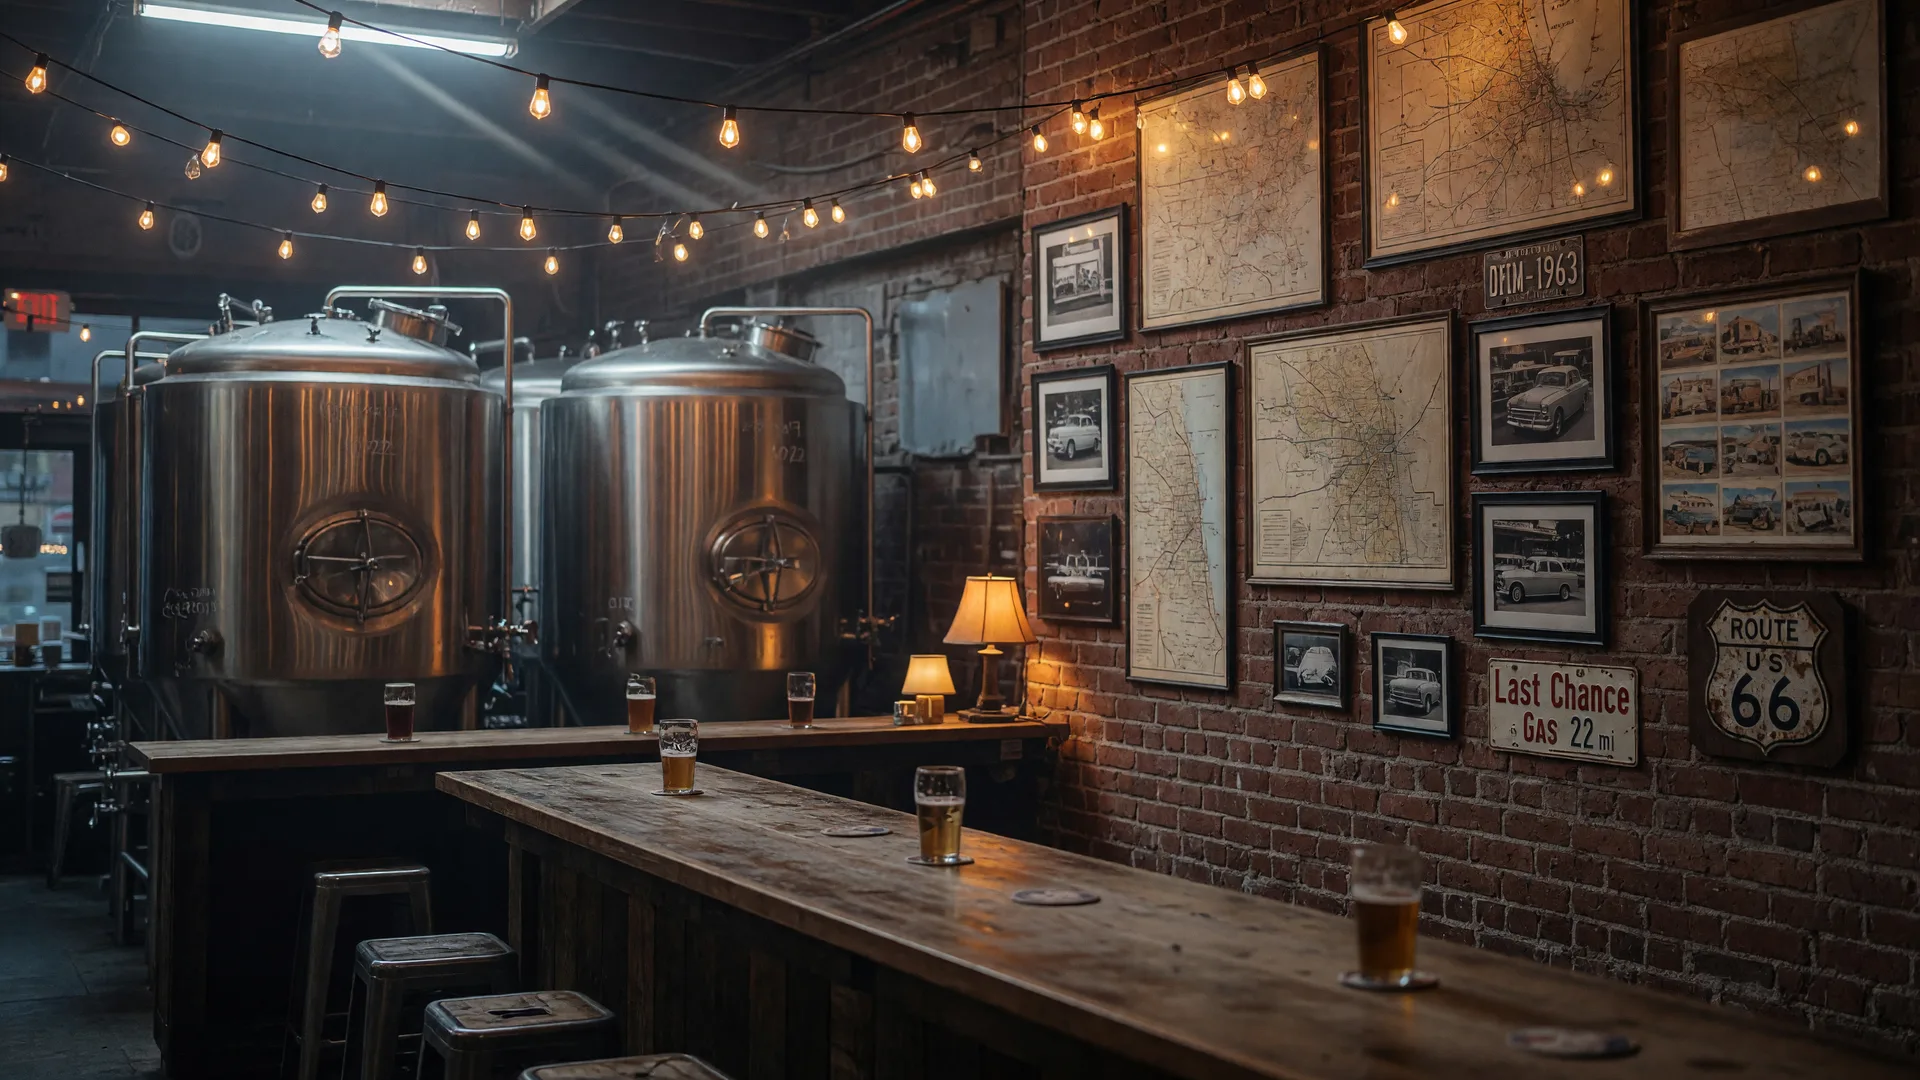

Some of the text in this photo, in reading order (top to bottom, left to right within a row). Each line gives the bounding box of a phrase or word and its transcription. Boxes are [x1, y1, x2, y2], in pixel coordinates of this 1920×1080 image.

[1730, 617, 1799, 642] ROUTE
[1746, 651, 1783, 673] US
[1495, 668, 1630, 715] Last Chance
[1731, 672, 1801, 731] 66
[1570, 716, 1594, 749] 22
[1599, 730, 1615, 751] mi
